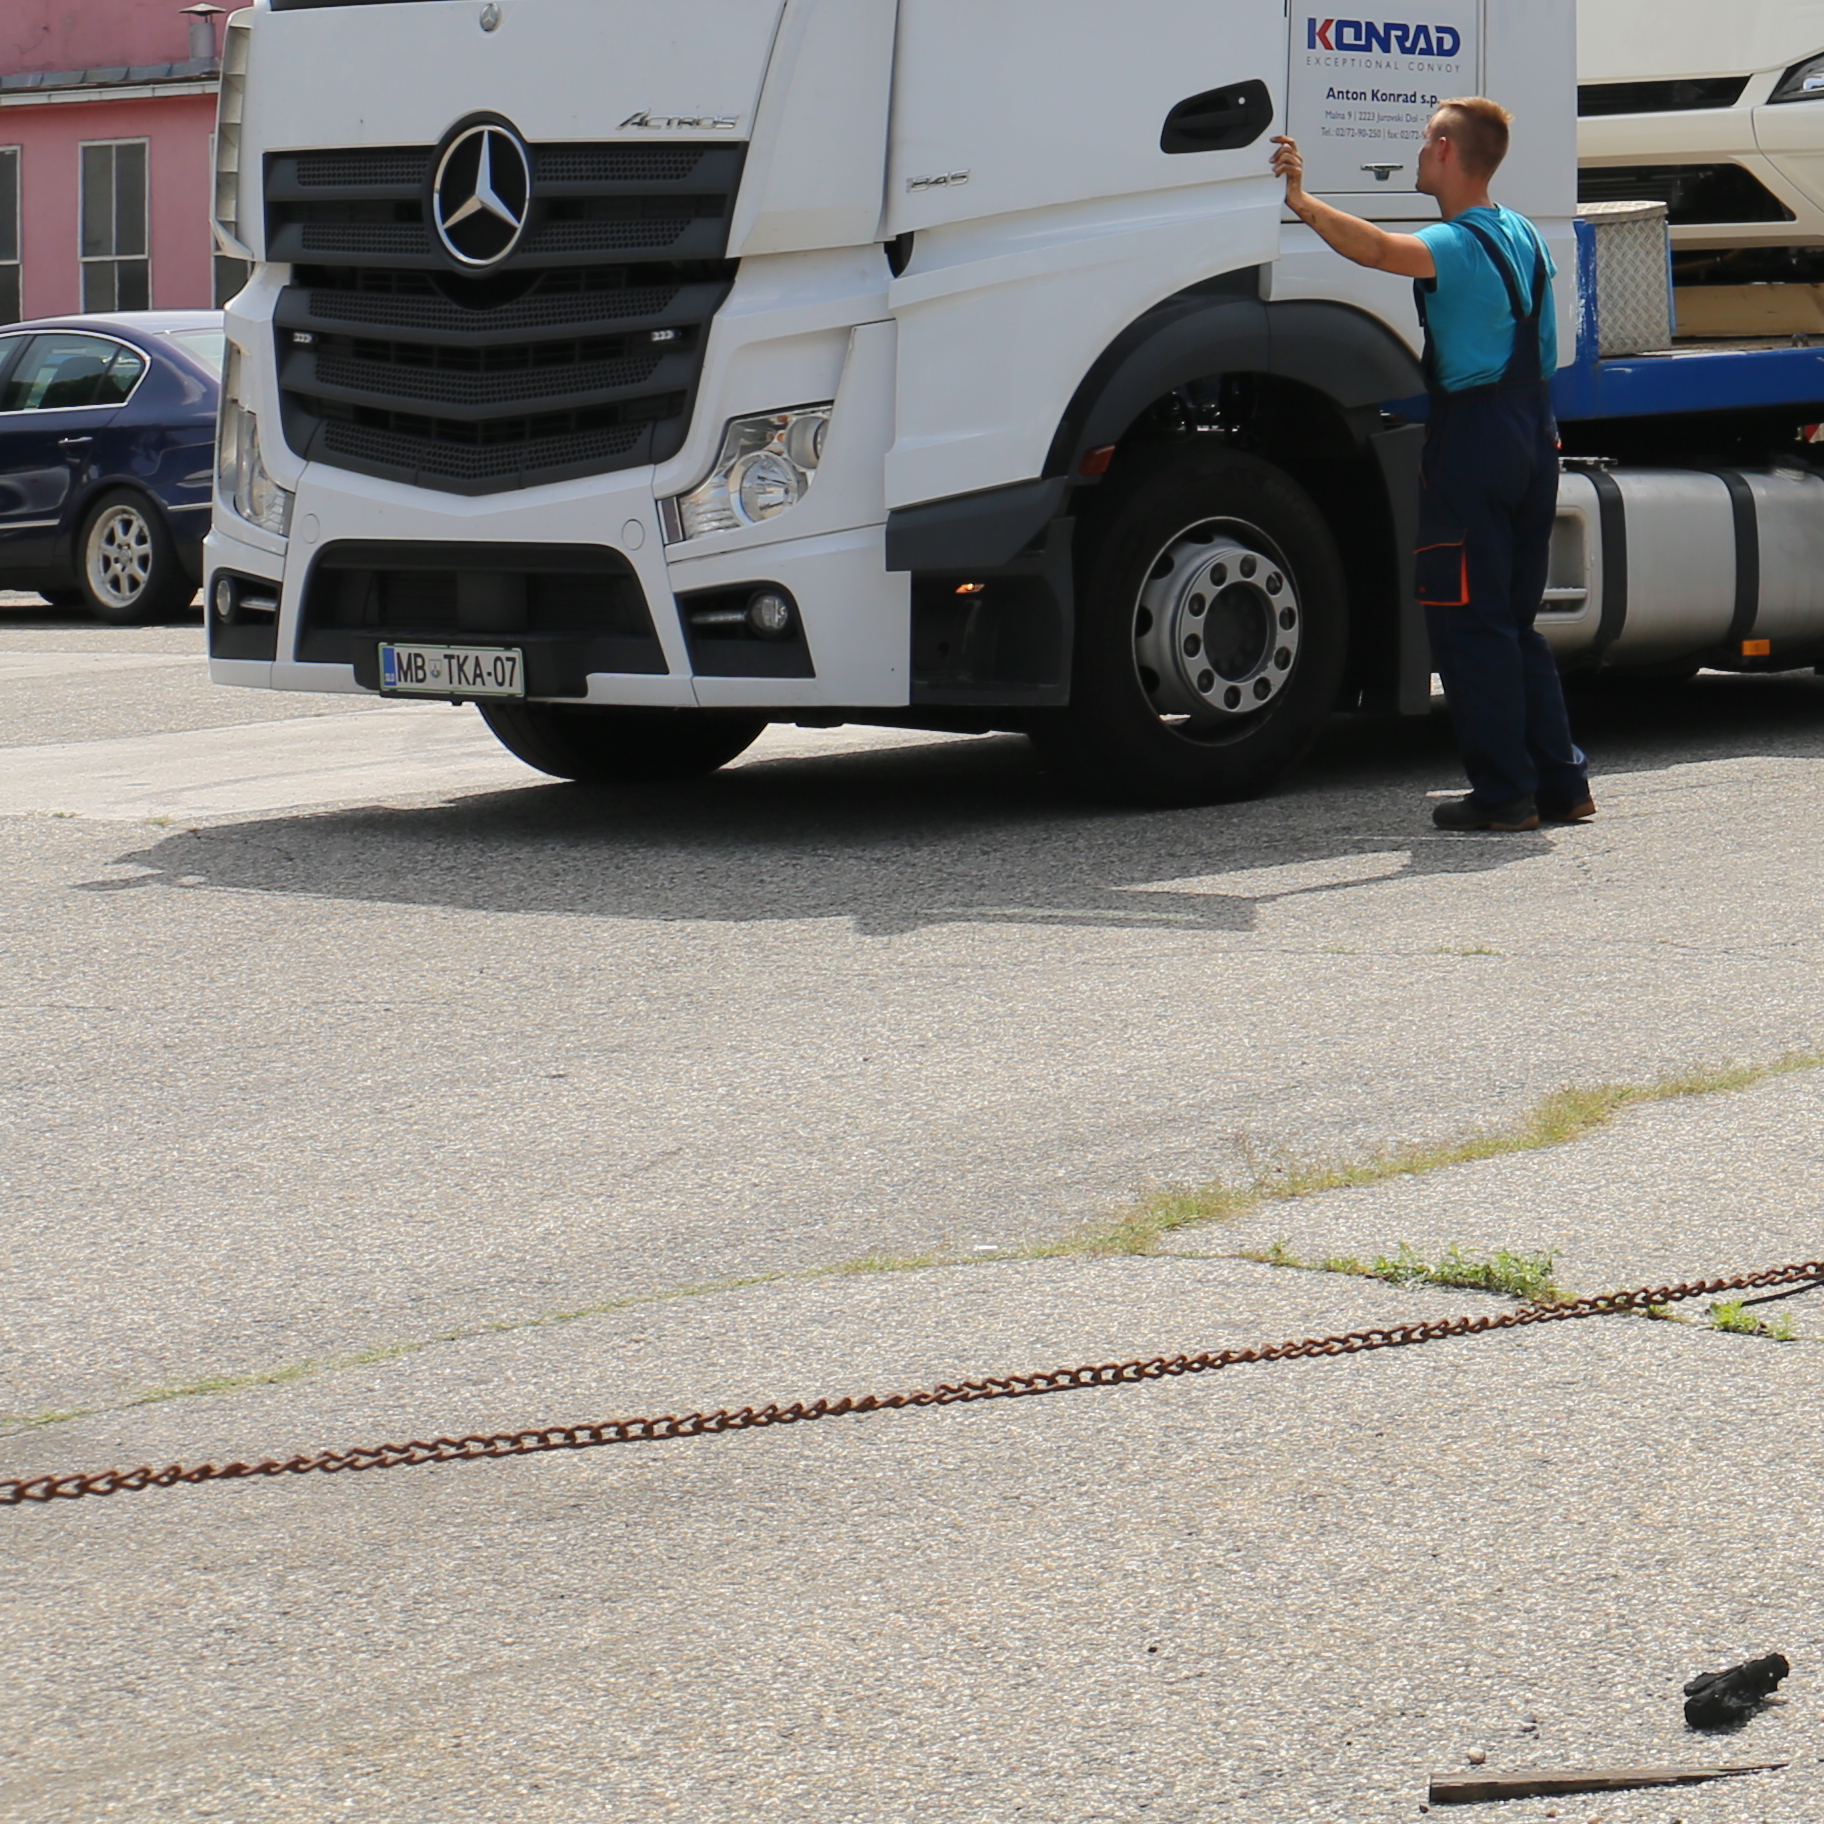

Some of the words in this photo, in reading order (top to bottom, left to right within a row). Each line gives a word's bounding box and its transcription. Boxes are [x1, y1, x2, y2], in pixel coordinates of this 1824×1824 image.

[1307, 17, 1461, 57] KONRAD
[1306, 56, 1399, 70] EXCEPTIONAL
[1408, 62, 1461, 73] CONVOY
[1326, 87, 1367, 101] Anton
[1371, 89, 1417, 104] Konrad
[1358, 111, 1376, 121] 2223
[1405, 113, 1418, 123] Dol
[396, 651, 427, 684] MB
[443, 653, 517, 688] TKA-07
